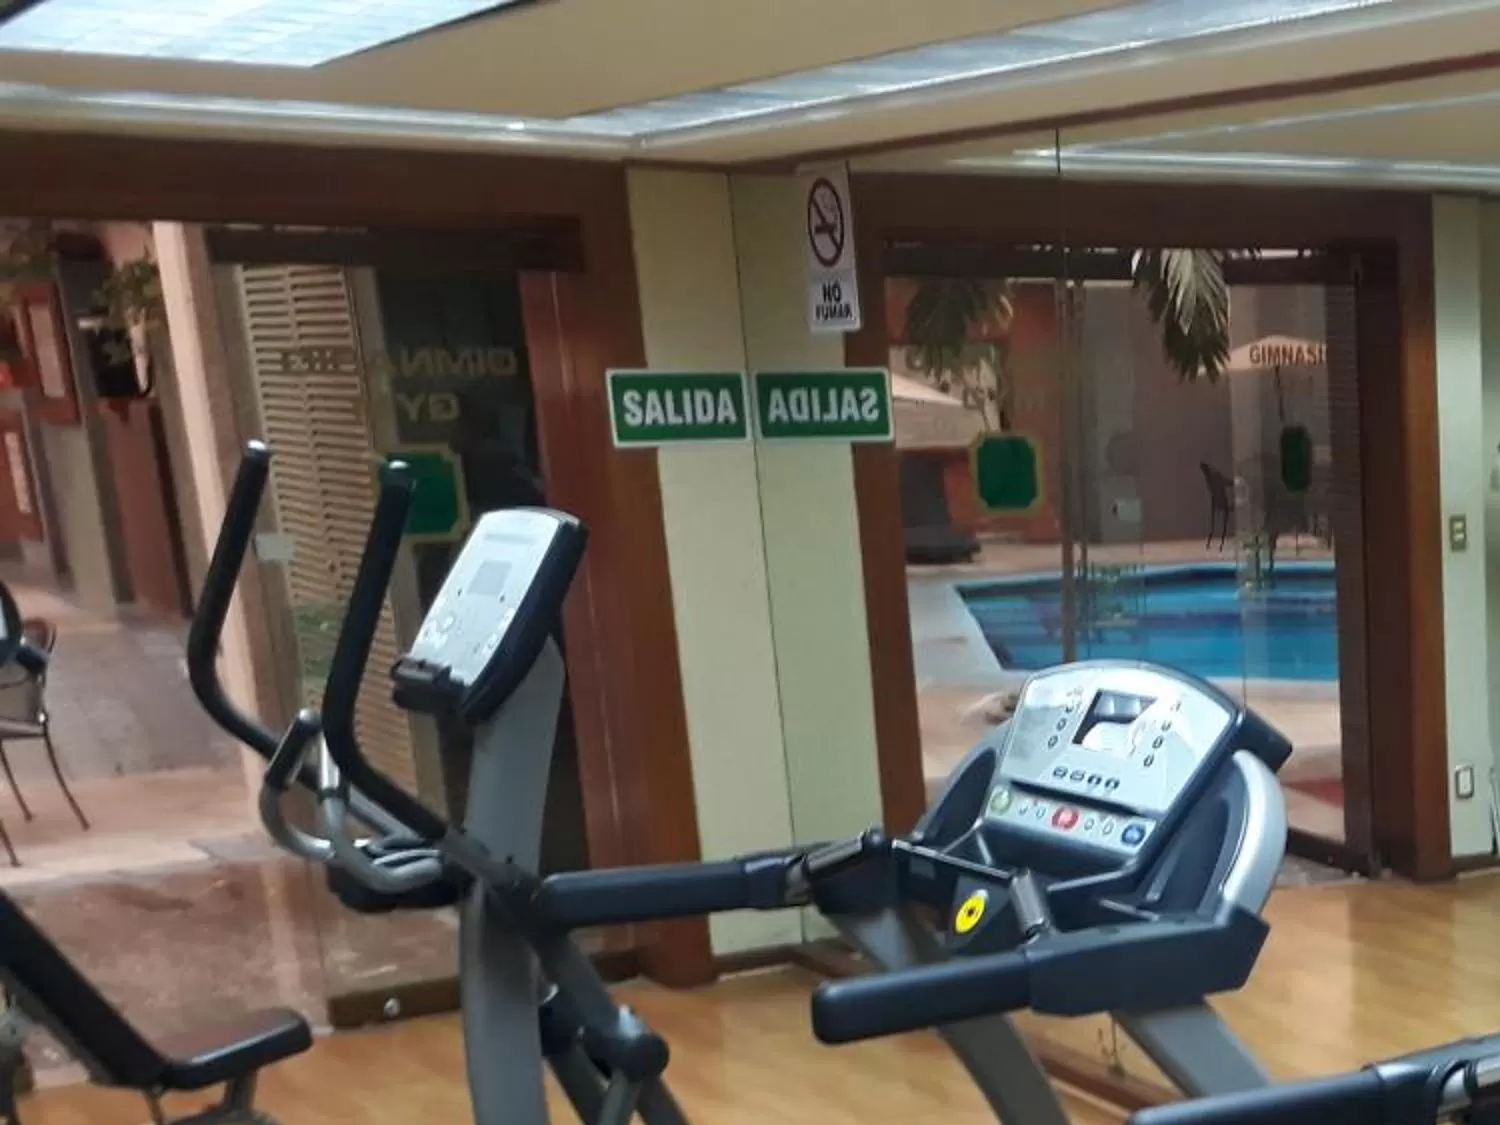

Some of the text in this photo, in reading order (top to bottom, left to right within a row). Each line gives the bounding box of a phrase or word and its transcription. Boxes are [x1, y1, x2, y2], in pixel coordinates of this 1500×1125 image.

[822, 281, 841, 302] NO
[815, 303, 853, 321] FUMAR
[1249, 343, 1329, 367] GIMNASI
[622, 387, 738, 427] SALIDA
